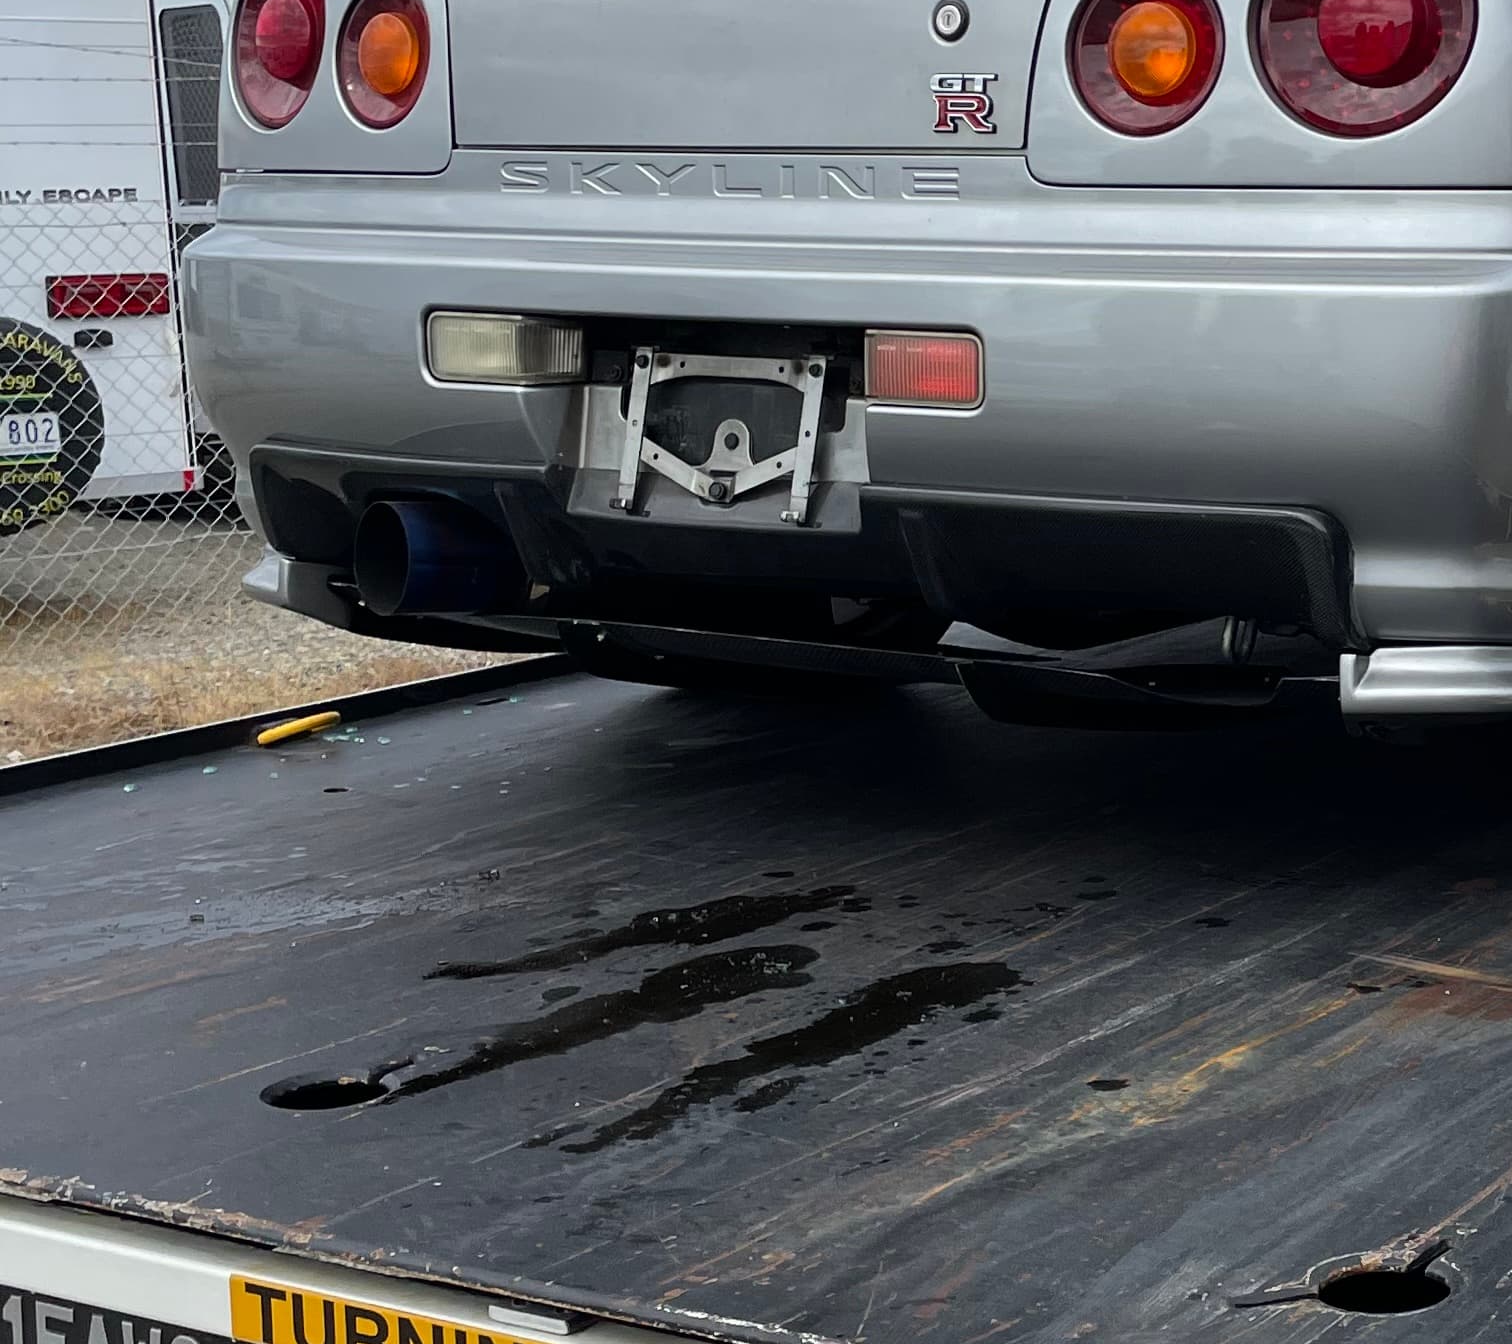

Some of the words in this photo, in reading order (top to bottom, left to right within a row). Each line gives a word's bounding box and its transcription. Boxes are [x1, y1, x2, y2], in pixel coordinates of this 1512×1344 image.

[42, 188, 138, 204] ESCAPE
[500, 160, 960, 201] SKYLINE
[0, 332, 83, 385] ARAVANS
[8, 417, 58, 445] 802
